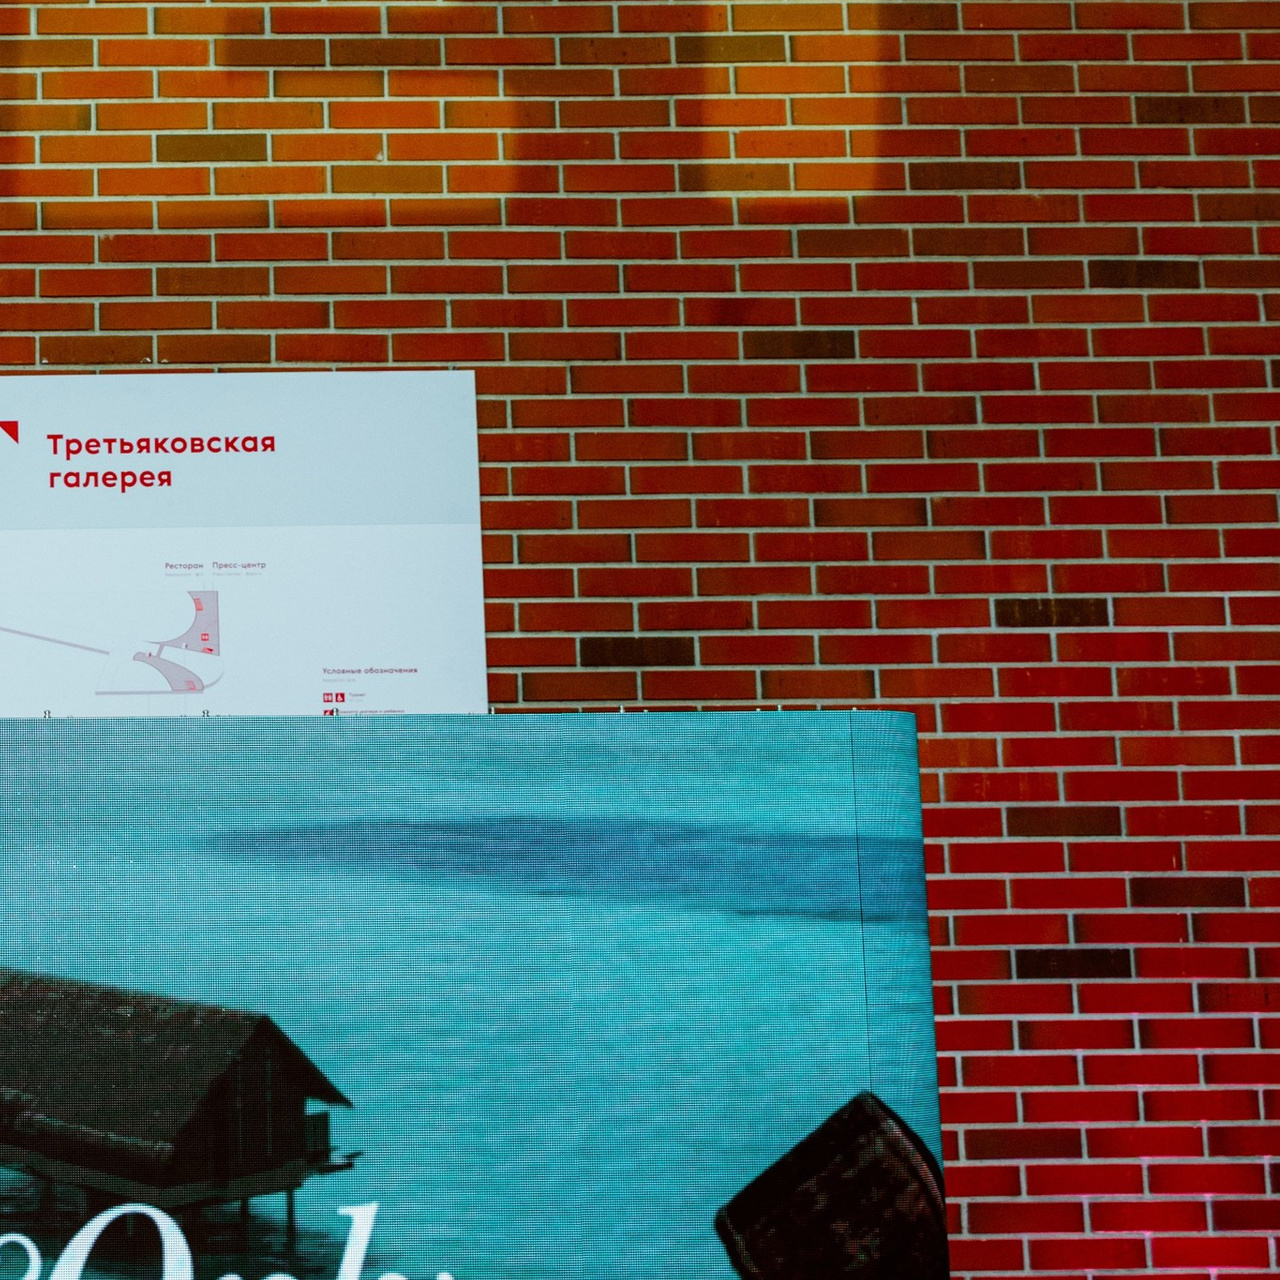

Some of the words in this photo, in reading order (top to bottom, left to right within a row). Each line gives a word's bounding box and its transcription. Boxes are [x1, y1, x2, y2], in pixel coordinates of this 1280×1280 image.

[46, 434, 276, 460] Третьяковская
[49, 470, 172, 494] галерея
[164, 562, 204, 570] Ресторан
[212, 561, 267, 570] Пресс-центр
[364, 666, 418, 674] обозначения
